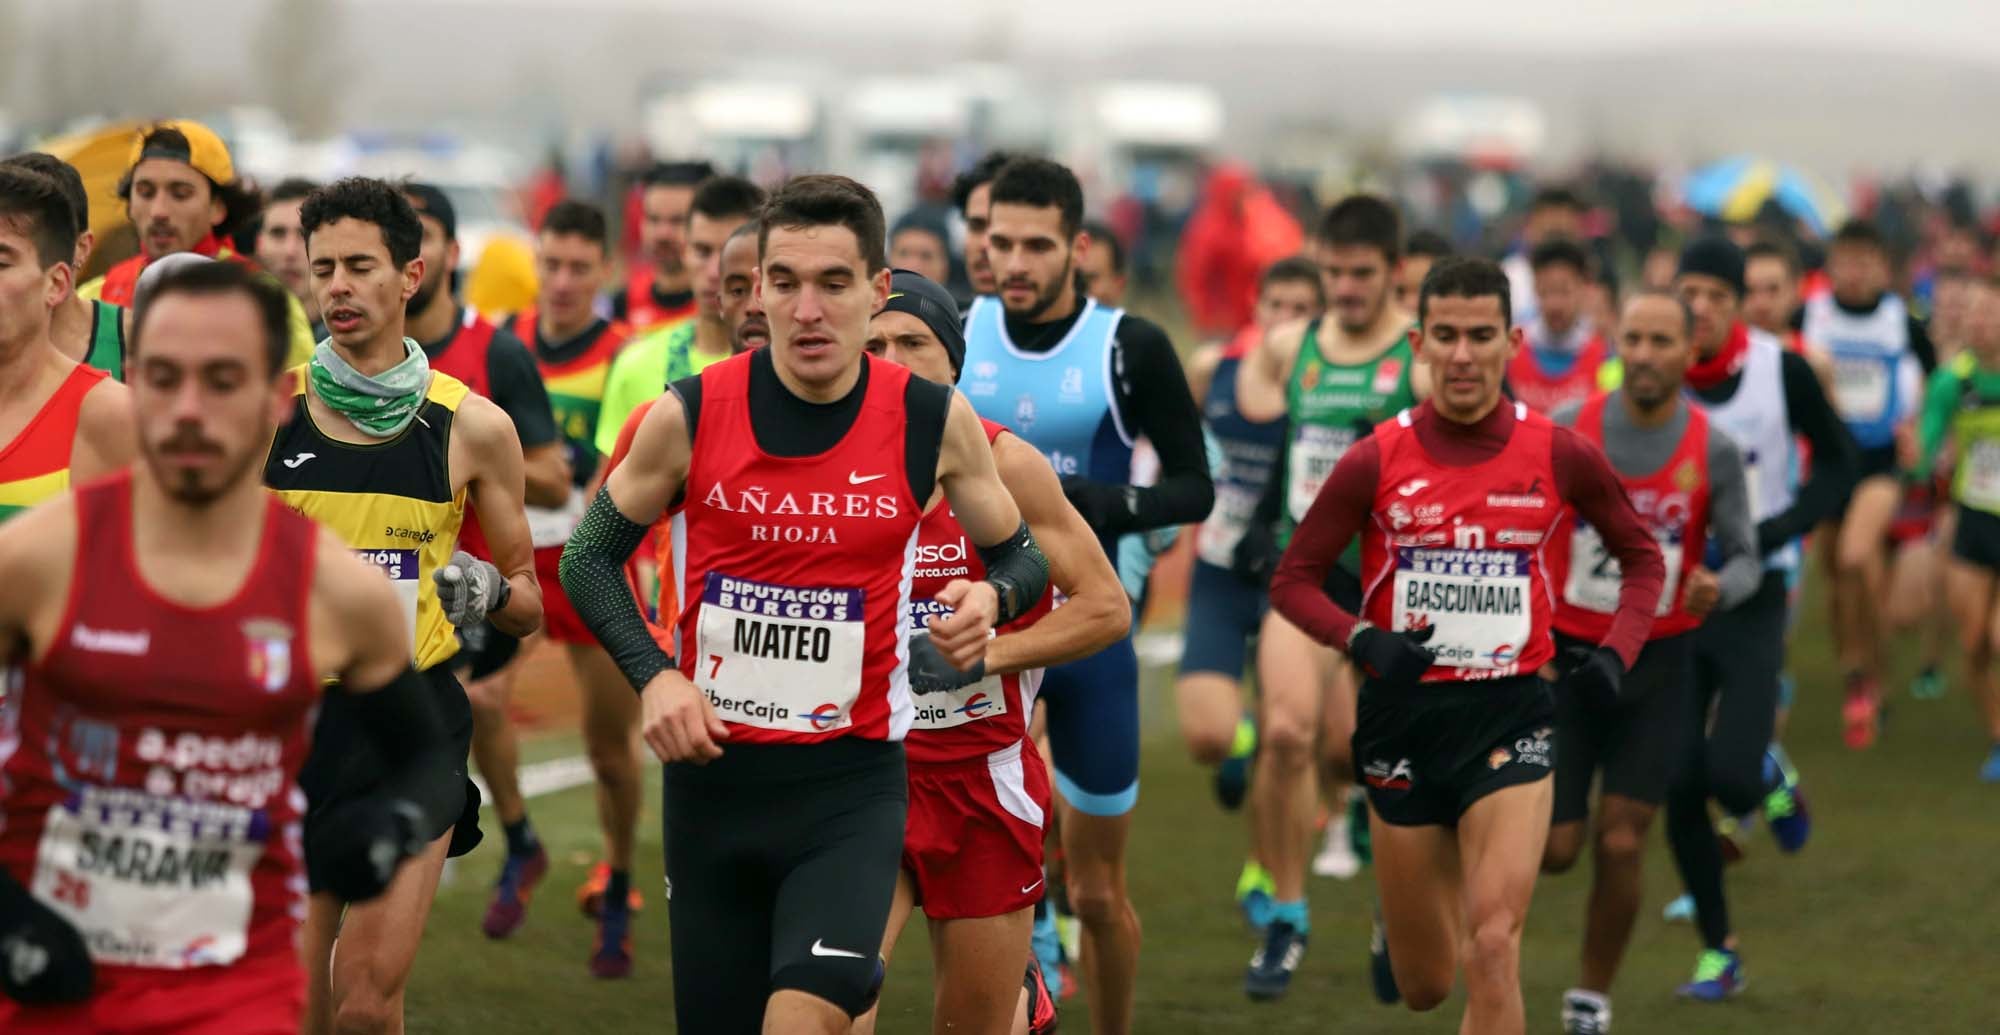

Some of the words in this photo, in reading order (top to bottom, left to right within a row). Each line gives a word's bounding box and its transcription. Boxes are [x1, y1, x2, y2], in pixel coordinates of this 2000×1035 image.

[702, 481, 899, 519] AÑARES
[394, 528, 437, 543] carede
[751, 525, 839, 544] RIOJA
[1453, 516, 1486, 550] in
[1411, 561, 1517, 577] BURGOS
[1412, 550, 1517, 565] DIPUTACIÓN
[912, 565, 968, 578] orca.com
[720, 578, 849, 605] DIPUTACIÓN
[1405, 578, 1522, 615] BASCUÑANA
[719, 592, 848, 621] BURGOS
[1405, 612, 1429, 631] 34
[733, 617, 831, 663] MATEO
[709, 654, 723, 680] 7
